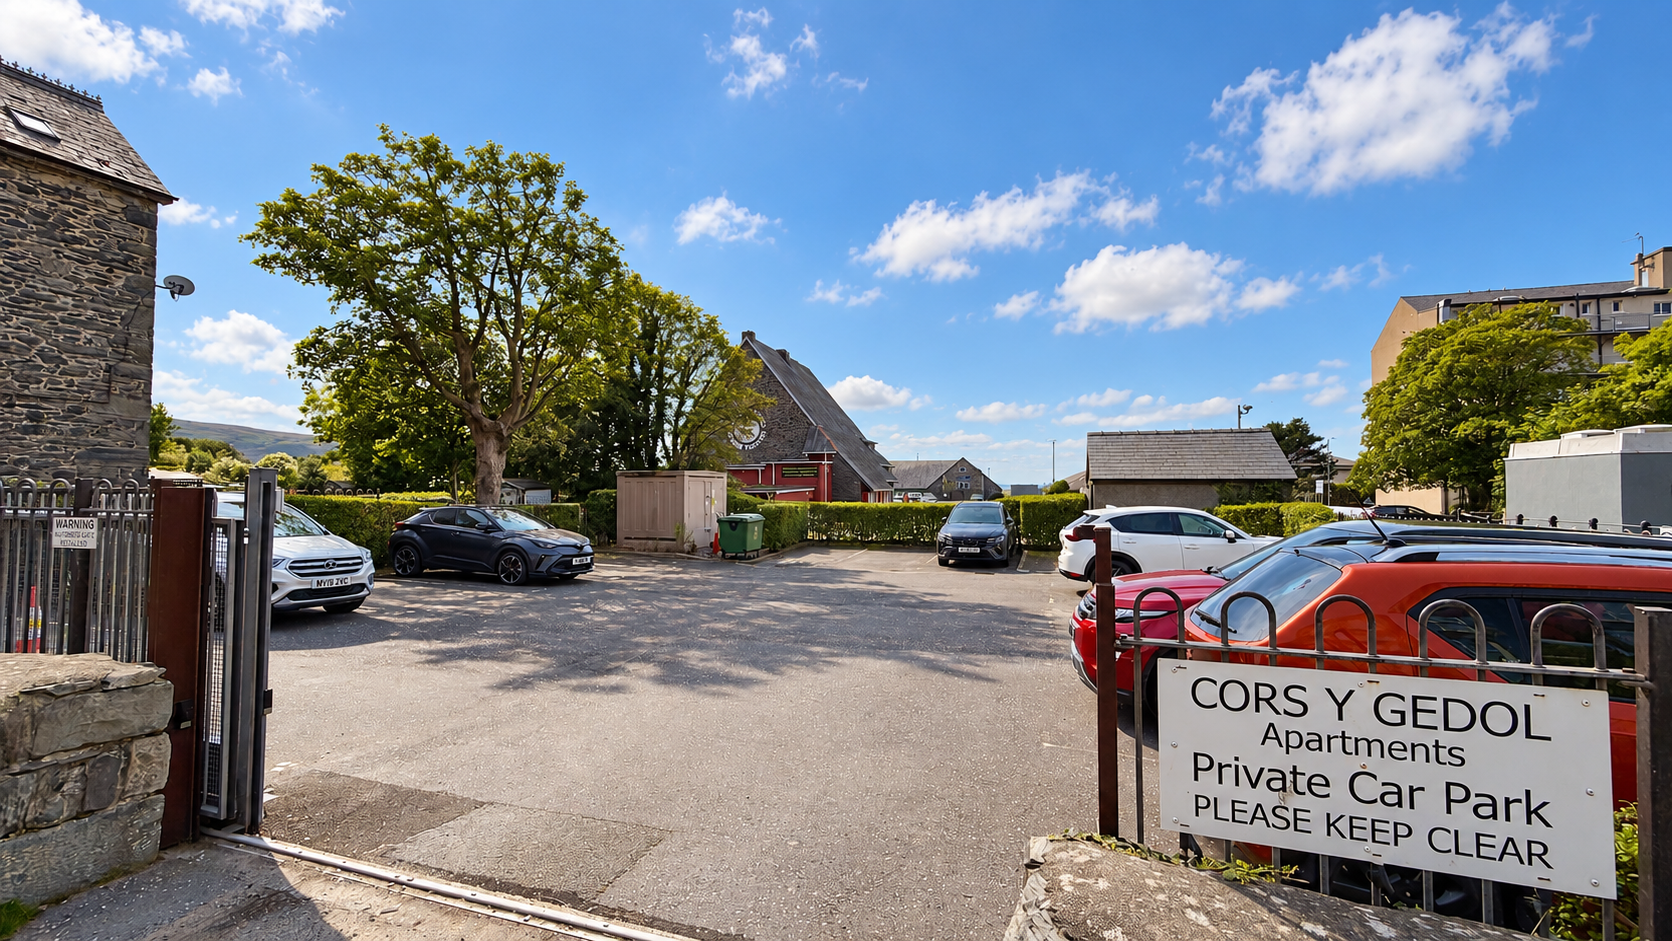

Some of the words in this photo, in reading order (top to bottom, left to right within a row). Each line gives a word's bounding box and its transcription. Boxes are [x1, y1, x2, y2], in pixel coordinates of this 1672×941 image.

[55, 519, 94, 530] WARNING
[1191, 677, 1309, 718] CORS
[1324, 687, 1356, 722] Y
[1373, 692, 1552, 742] GEDOL
[1260, 722, 1466, 768] Apartments
[1193, 751, 1331, 799] Private
[1348, 770, 1426, 810] Car
[1445, 781, 1554, 829] Park
[1194, 794, 1312, 835] PLEASE
[1325, 812, 1413, 848] KEEP
[1427, 826, 1554, 870] CLEAR
